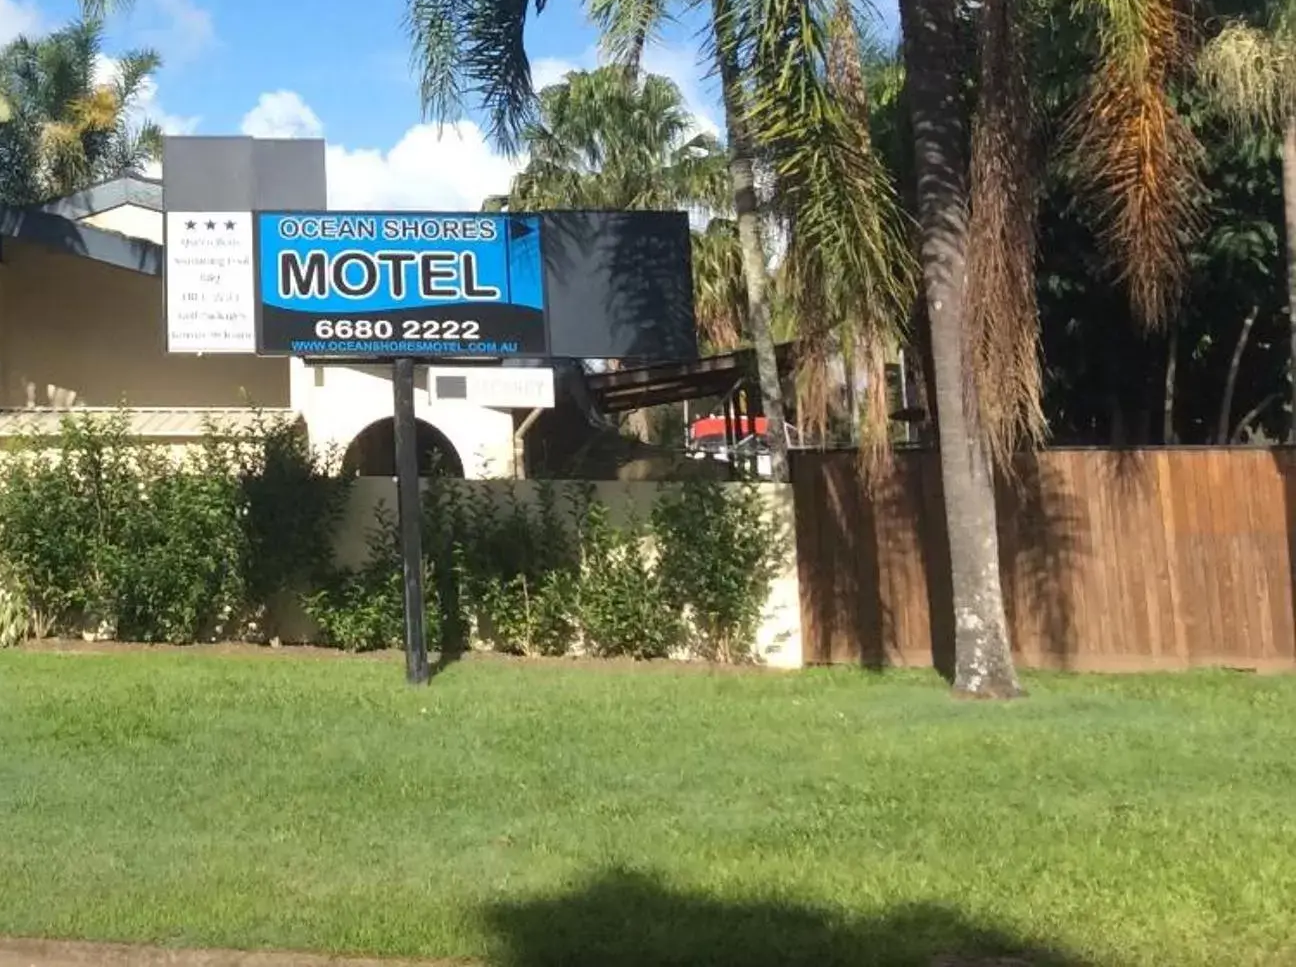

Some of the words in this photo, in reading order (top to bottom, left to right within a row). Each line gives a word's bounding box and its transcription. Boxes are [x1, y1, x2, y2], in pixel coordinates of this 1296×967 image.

[280, 217, 375, 240] OCEAN
[383, 218, 496, 240] SHORES
[278, 250, 501, 301] MOTEL
[315, 320, 393, 339] 6680
[402, 320, 480, 339] 2222
[292, 340, 518, 353] WWW.OCEANSHORESMOTEL.COM.AU
